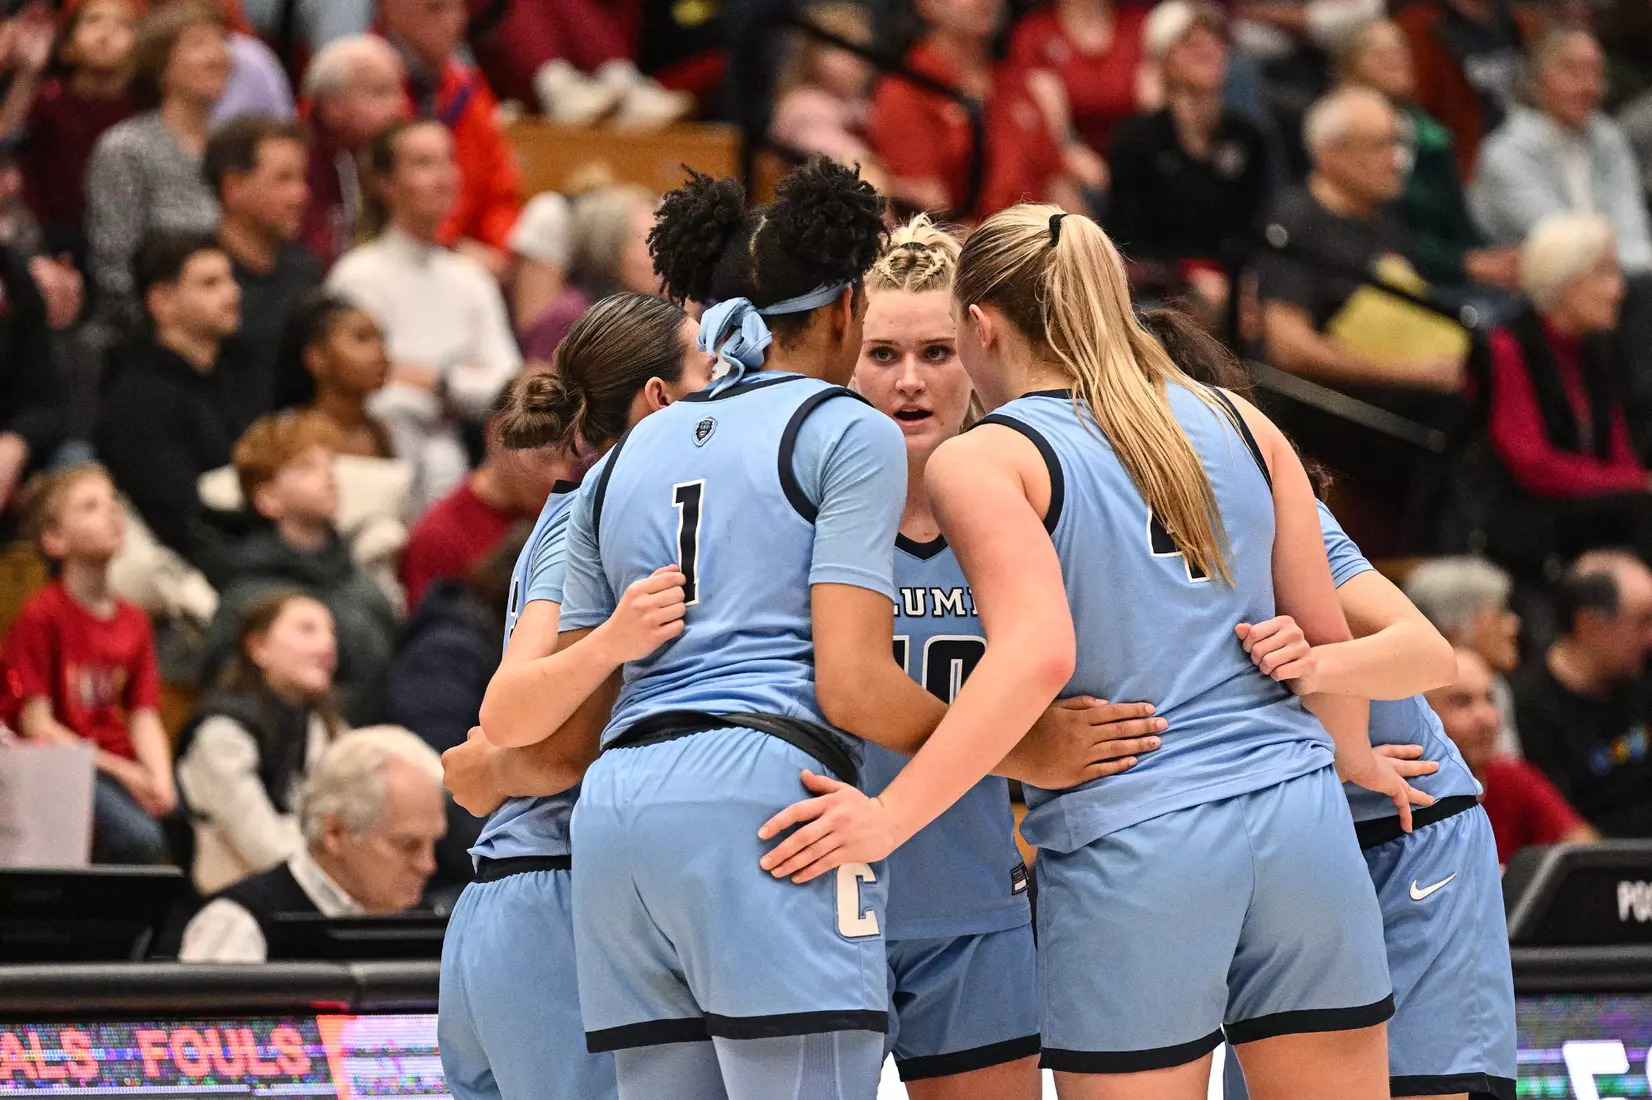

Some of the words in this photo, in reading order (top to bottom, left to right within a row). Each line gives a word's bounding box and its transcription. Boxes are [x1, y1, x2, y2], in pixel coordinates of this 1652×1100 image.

[672, 479, 706, 606] 1
[893, 587, 978, 617] UM
[836, 861, 881, 938] C
[1617, 880, 1652, 922] PO
[136, 1026, 311, 1077] FOULS
